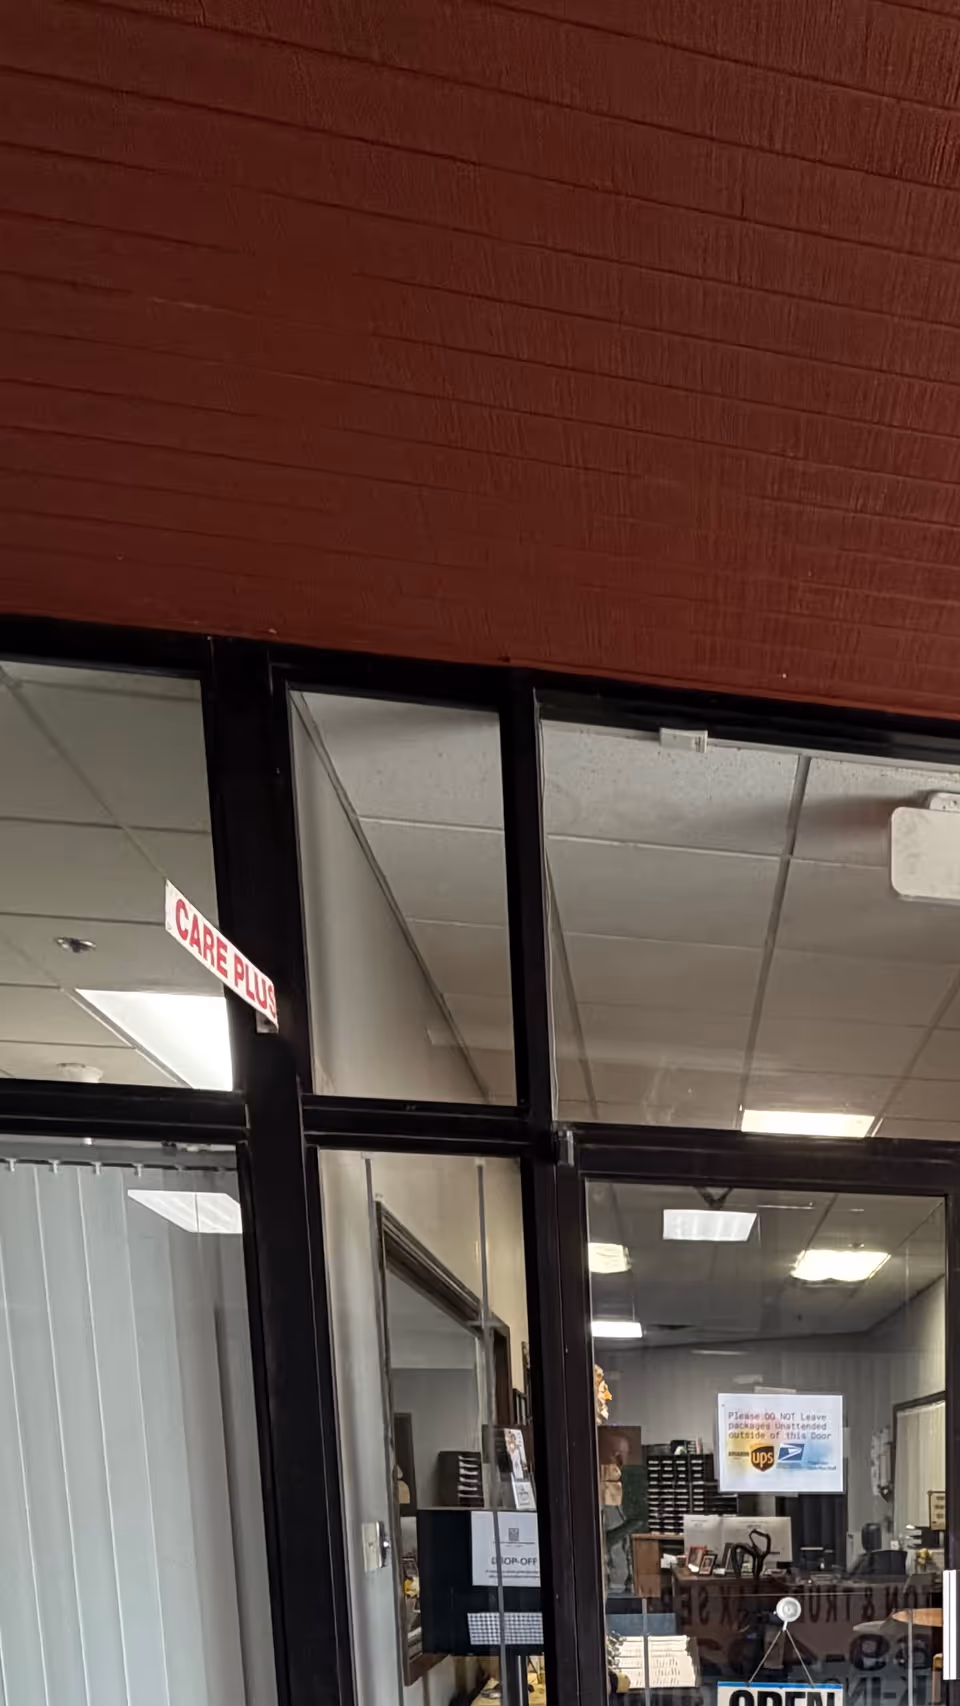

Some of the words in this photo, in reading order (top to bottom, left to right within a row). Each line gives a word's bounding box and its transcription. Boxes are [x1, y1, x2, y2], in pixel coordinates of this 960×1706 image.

[175, 898, 229, 980] CARE
[233, 952, 277, 1020] PLUS
[728, 1411, 760, 1420] Please
[764, 1412, 776, 1420] DO
[780, 1412, 795, 1421] NOT
[800, 1412, 827, 1421] Leave
[728, 1422, 770, 1431] packages
[775, 1422, 827, 1431] Unattended
[728, 1431, 766, 1440] outside
[769, 1431, 780, 1440] of
[786, 1432, 807, 1440] this
[810, 1432, 832, 1440] Door
[752, 1451, 774, 1468] ups
[491, 1556, 537, 1566] DOP-OFF
